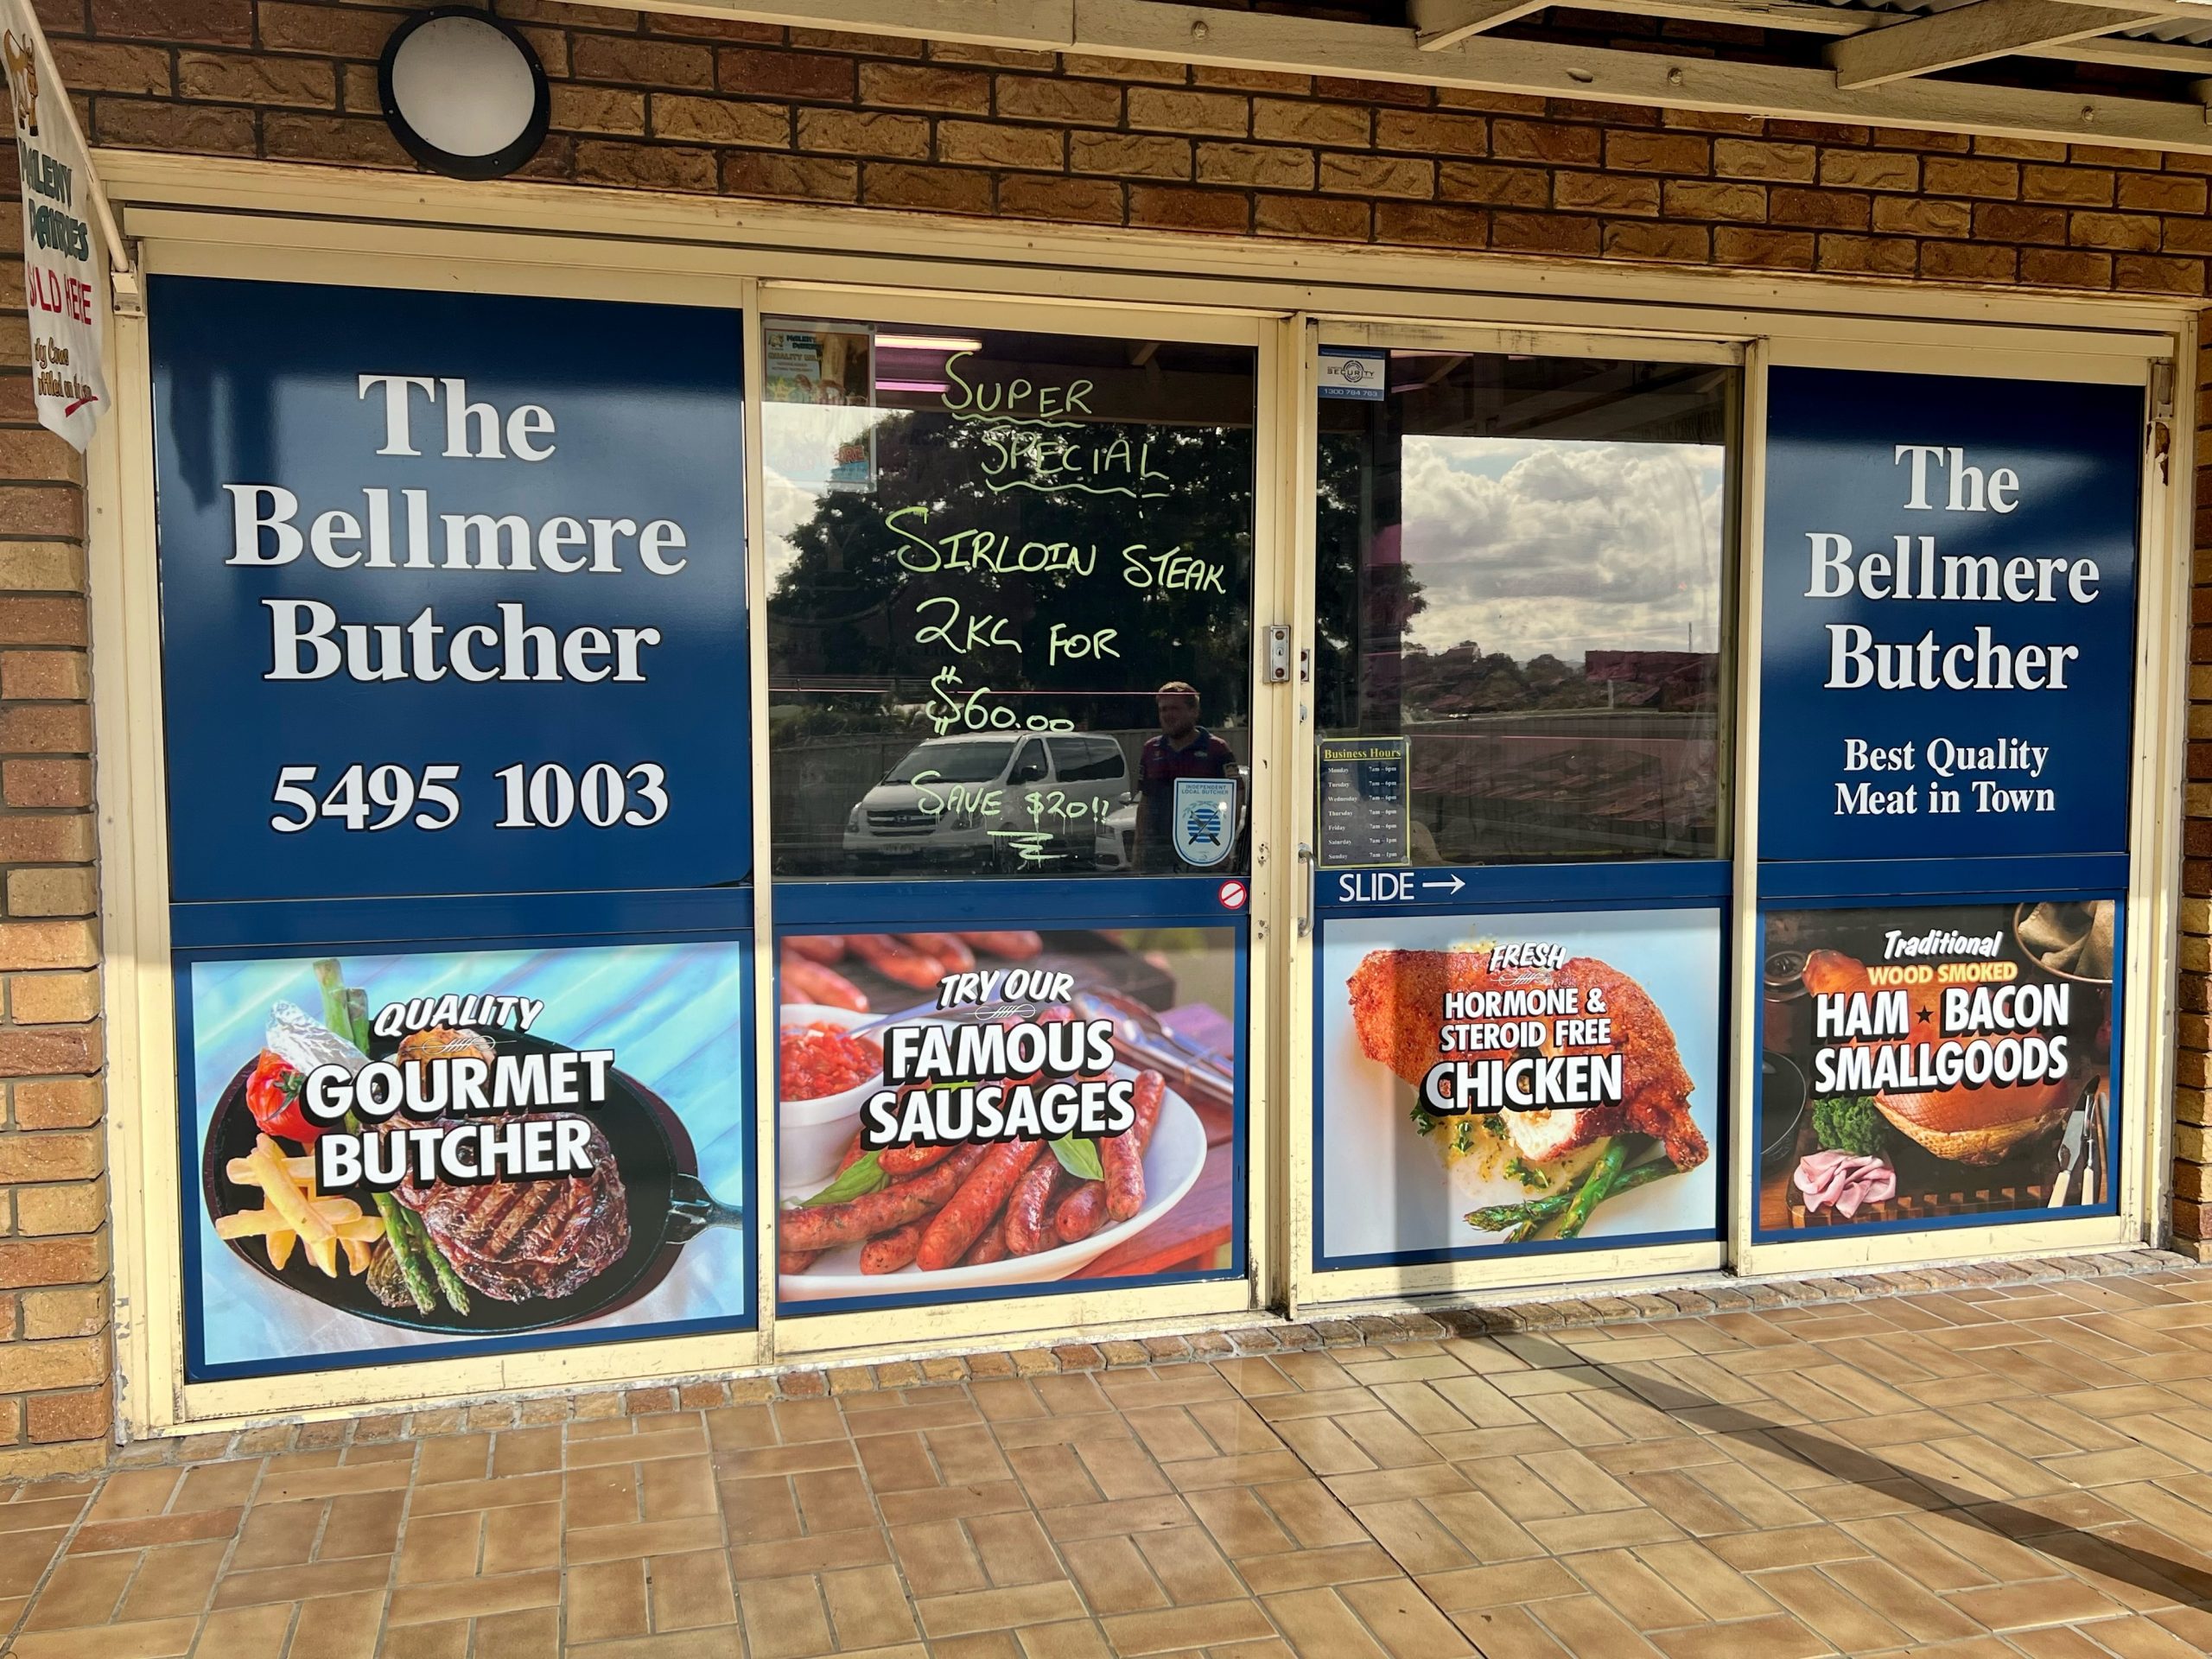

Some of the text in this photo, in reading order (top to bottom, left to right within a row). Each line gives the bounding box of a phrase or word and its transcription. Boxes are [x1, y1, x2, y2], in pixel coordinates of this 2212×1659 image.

[941, 351, 1094, 417] SUPER
[359, 374, 556, 461] The
[981, 424, 1170, 480] SPECIAL
[1895, 445, 2020, 513] The
[222, 484, 687, 575] Bellmere
[885, 506, 1226, 594] SIRLOIN STEAK
[1804, 532, 2101, 603] Bellmere
[262, 599, 661, 682] Butcher
[1049, 623, 1121, 666] FOR
[1824, 624, 2079, 690] Butcher
[925, 665, 1075, 735] $60.00
[1324, 747, 1402, 760] Business Hours
[1844, 737, 2050, 779] Best Quality
[270, 763, 670, 832] 5495 1003
[911, 769, 1003, 817] SAVE
[1834, 781, 2056, 816] Meat in Town
[1339, 872, 1414, 902] SLIDE
[1489, 942, 1567, 973] FRESH
[1884, 928, 2004, 960] Traditional
[940, 968, 1075, 1007] TRY OUR
[1866, 961, 2018, 986] WOOD SMOKED
[373, 995, 544, 1037] QUALITY
[1445, 987, 1607, 1020] HORMONE &
[1816, 982, 2070, 1038] HAM BACON
[891, 1019, 1115, 1079] FAMOUS
[1440, 1018, 1611, 1052] STEROID FREE
[305, 1050, 614, 1119] GOURMET
[1426, 1054, 1624, 1110] CHICKEN
[1815, 1035, 2069, 1094] SMALLGOODS
[868, 1080, 1135, 1144] SAUSAGES
[321, 1120, 595, 1188] BUTCHER
